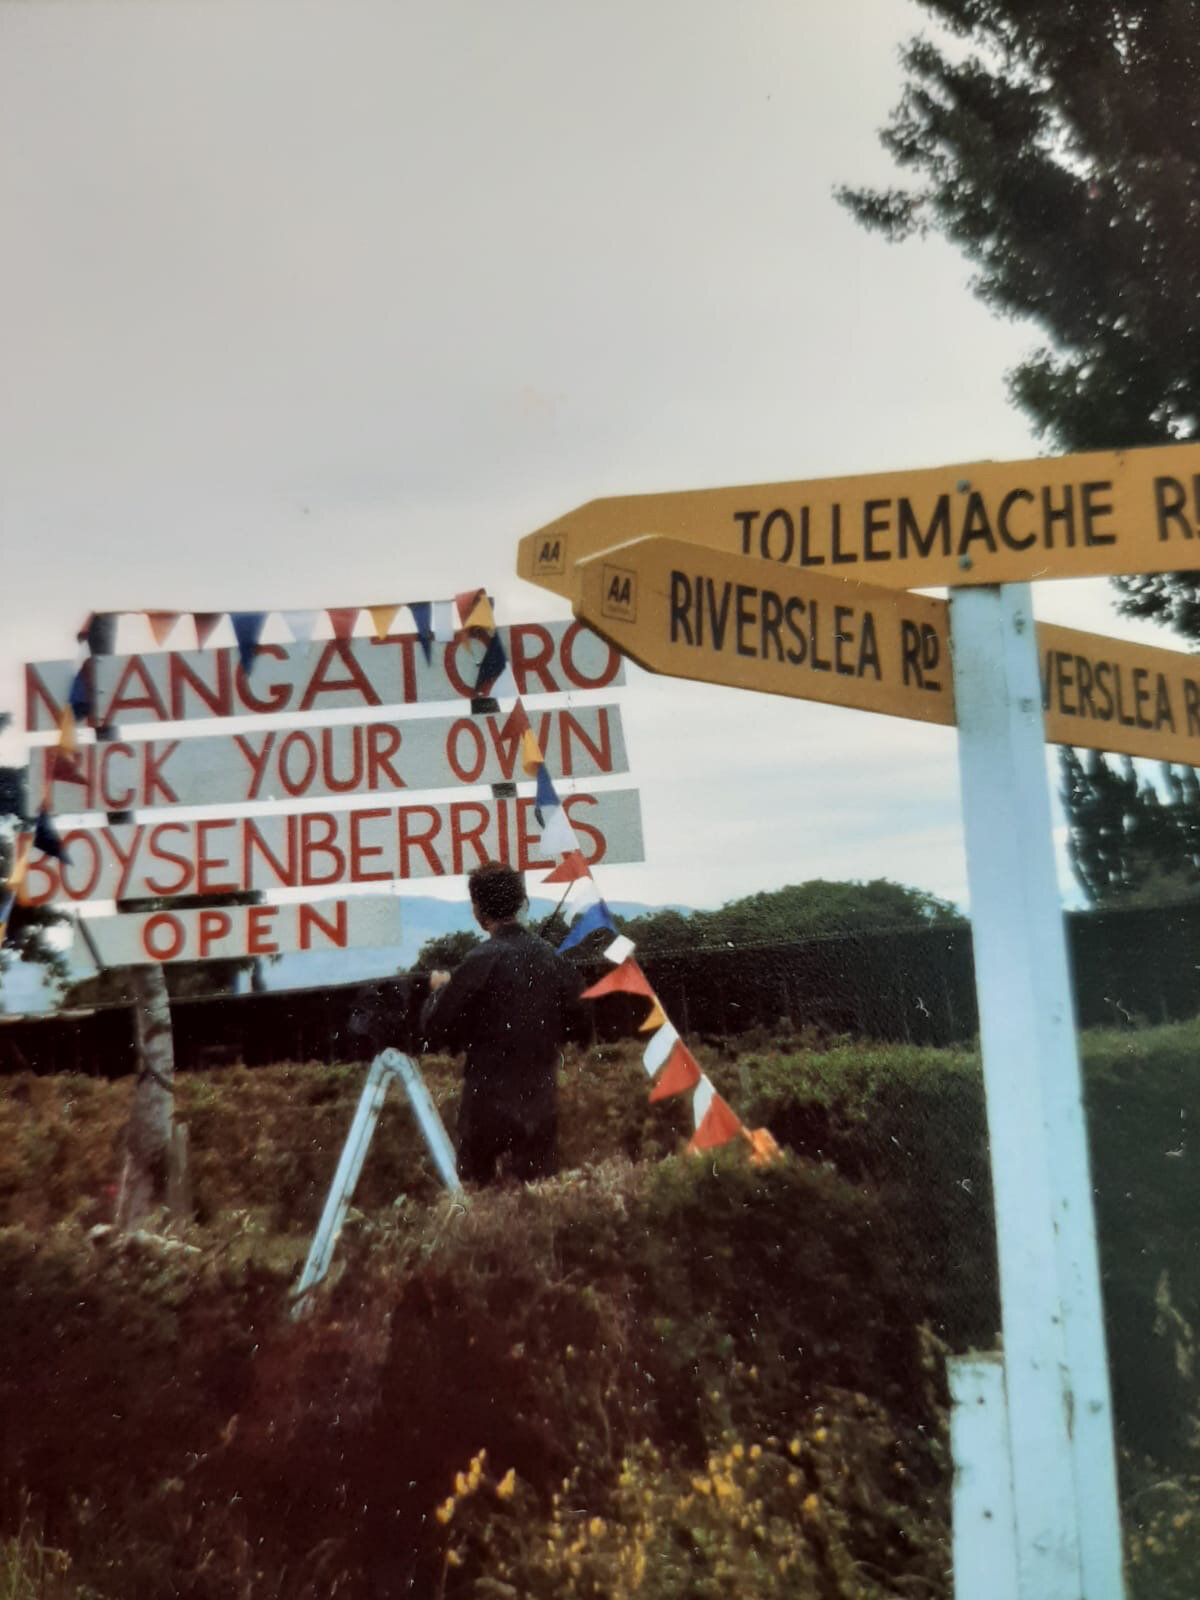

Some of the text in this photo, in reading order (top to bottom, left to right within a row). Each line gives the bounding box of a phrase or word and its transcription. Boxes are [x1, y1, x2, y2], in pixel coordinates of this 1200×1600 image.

[538, 541, 560, 562] AA
[733, 481, 1117, 567] TOLLEMACHE
[607, 575, 631, 604] AA
[669, 570, 942, 691] RIVERSLEA RD
[24, 622, 622, 732] MANGATORO
[233, 722, 407, 798] YOUR
[446, 707, 613, 783] OWN
[15, 792, 607, 906] BOYSENBERRIES
[143, 901, 348, 960] OPEN
